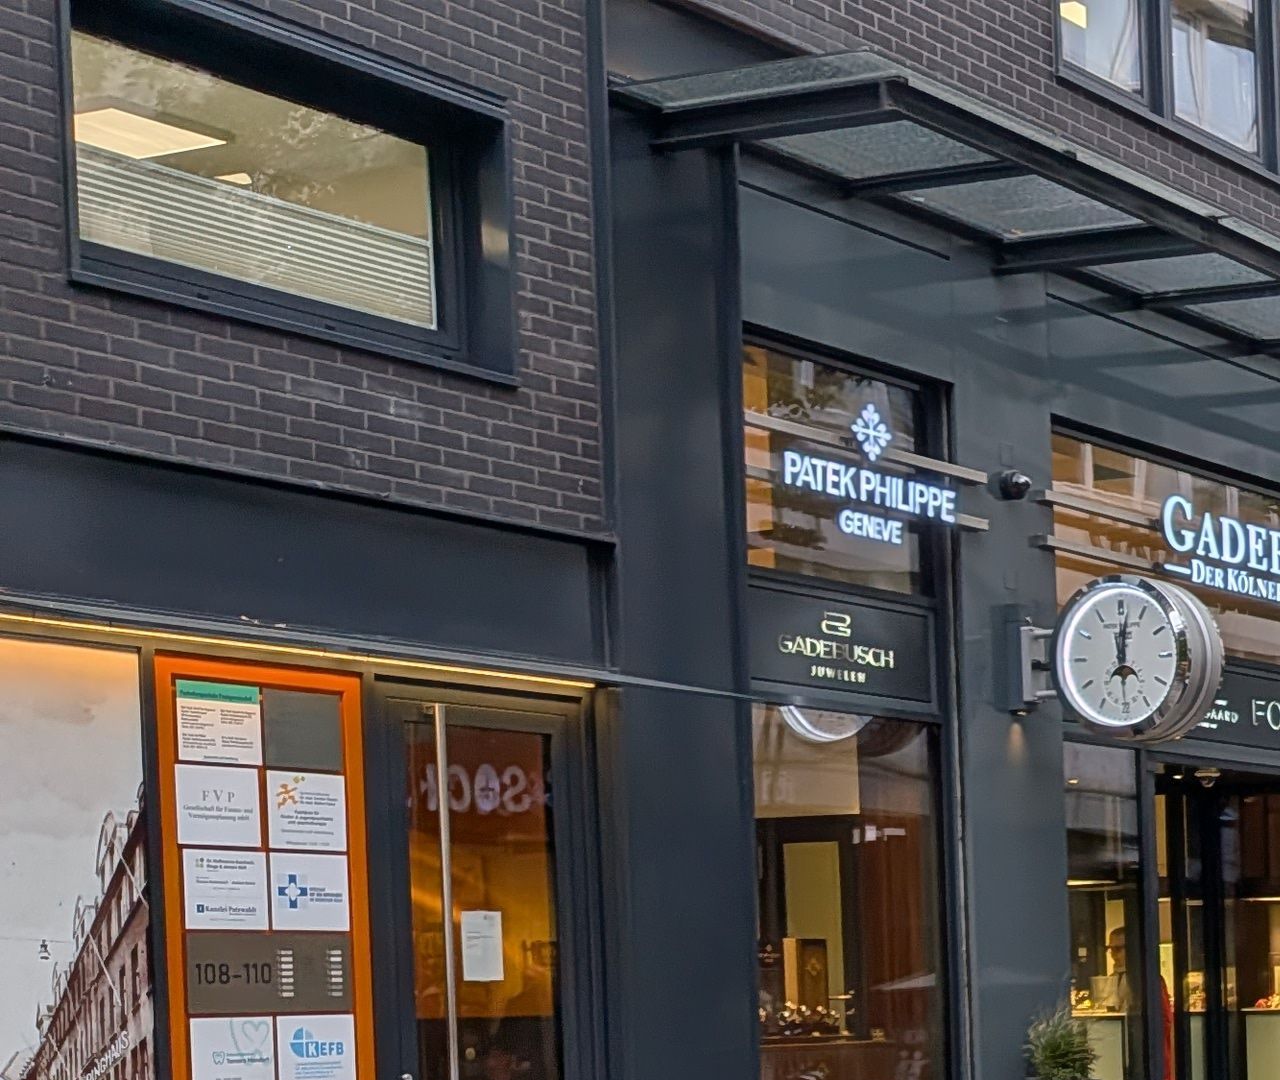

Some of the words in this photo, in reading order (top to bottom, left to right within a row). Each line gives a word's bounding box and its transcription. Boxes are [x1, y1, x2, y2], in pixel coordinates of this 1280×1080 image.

[783, 451, 857, 499] PATEK
[859, 469, 957, 523] PHILIPPE
[1191, 559, 1225, 588] DER
[778, 634, 895, 669] GADEBUSCH
[811, 665, 866, 684] JUWELEN
[195, 963, 272, 985] 108-110
